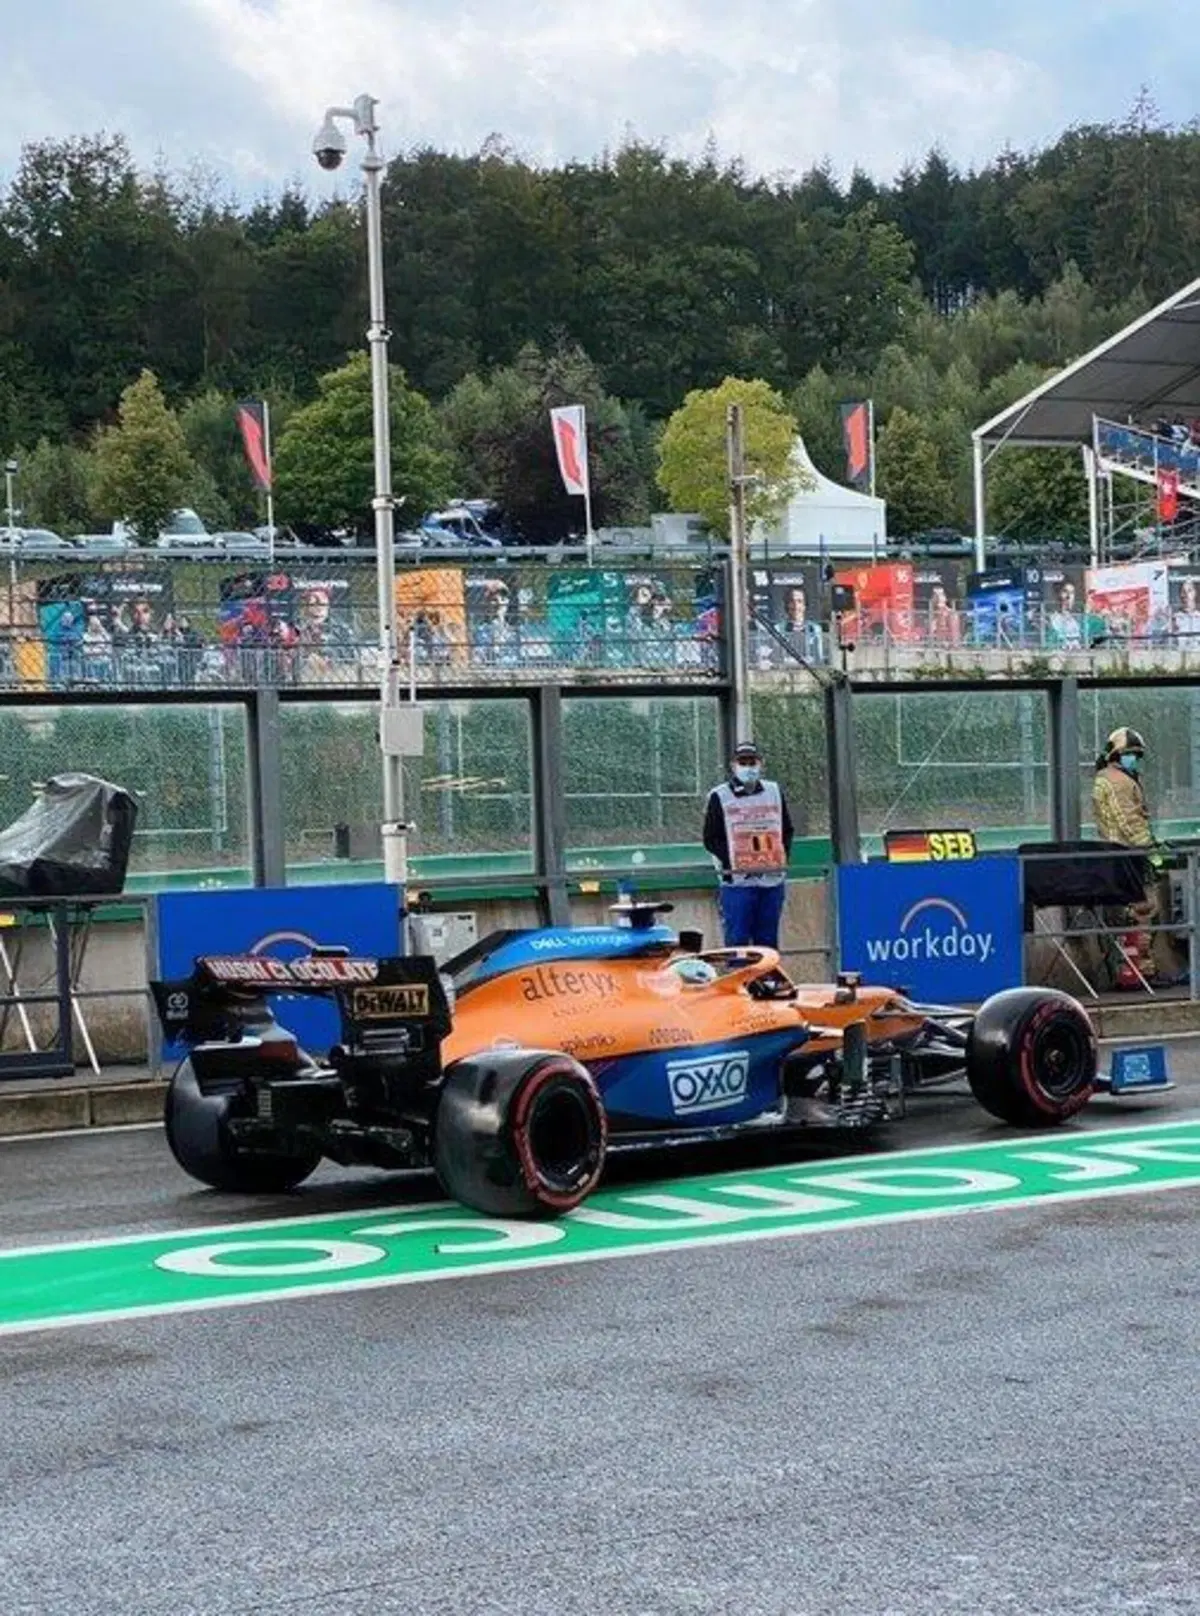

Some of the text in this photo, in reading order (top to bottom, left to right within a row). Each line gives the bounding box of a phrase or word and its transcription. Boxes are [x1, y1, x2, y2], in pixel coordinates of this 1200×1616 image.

[927, 831, 975, 861] SEB
[867, 927, 992, 963] workday
[207, 960, 271, 980] HUSKI
[520, 967, 621, 1001] alteryx
[673, 1057, 745, 1102] OXXO
